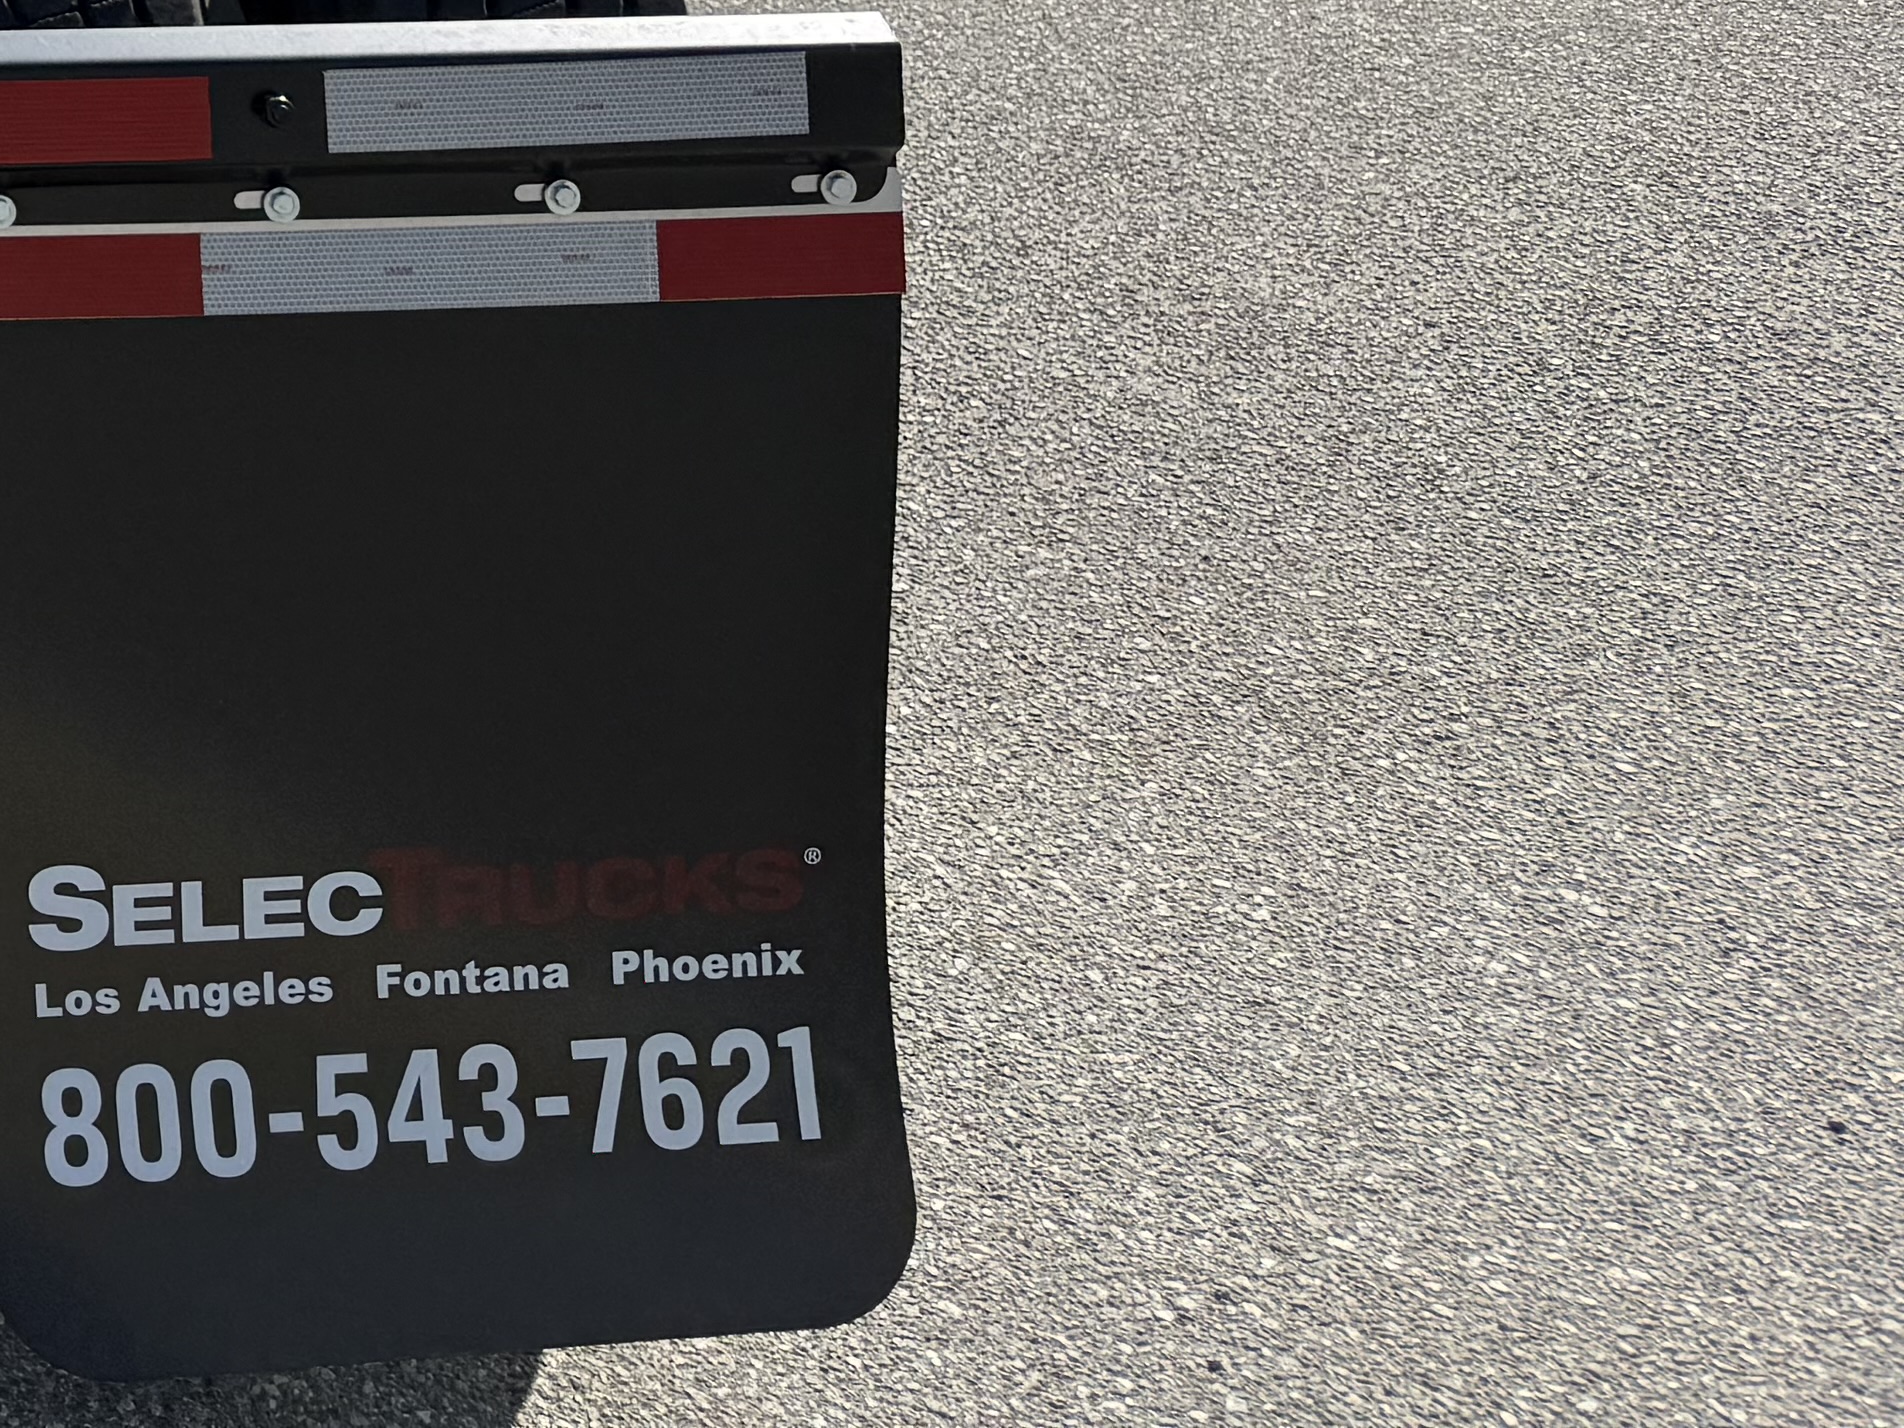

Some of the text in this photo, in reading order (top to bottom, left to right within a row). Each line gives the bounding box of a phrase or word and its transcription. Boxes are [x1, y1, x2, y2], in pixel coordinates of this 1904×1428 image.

[35, 943, 804, 1017] Los Angeles Fontana Phoenix
[42, 1027, 821, 1186] 800-543-7621
